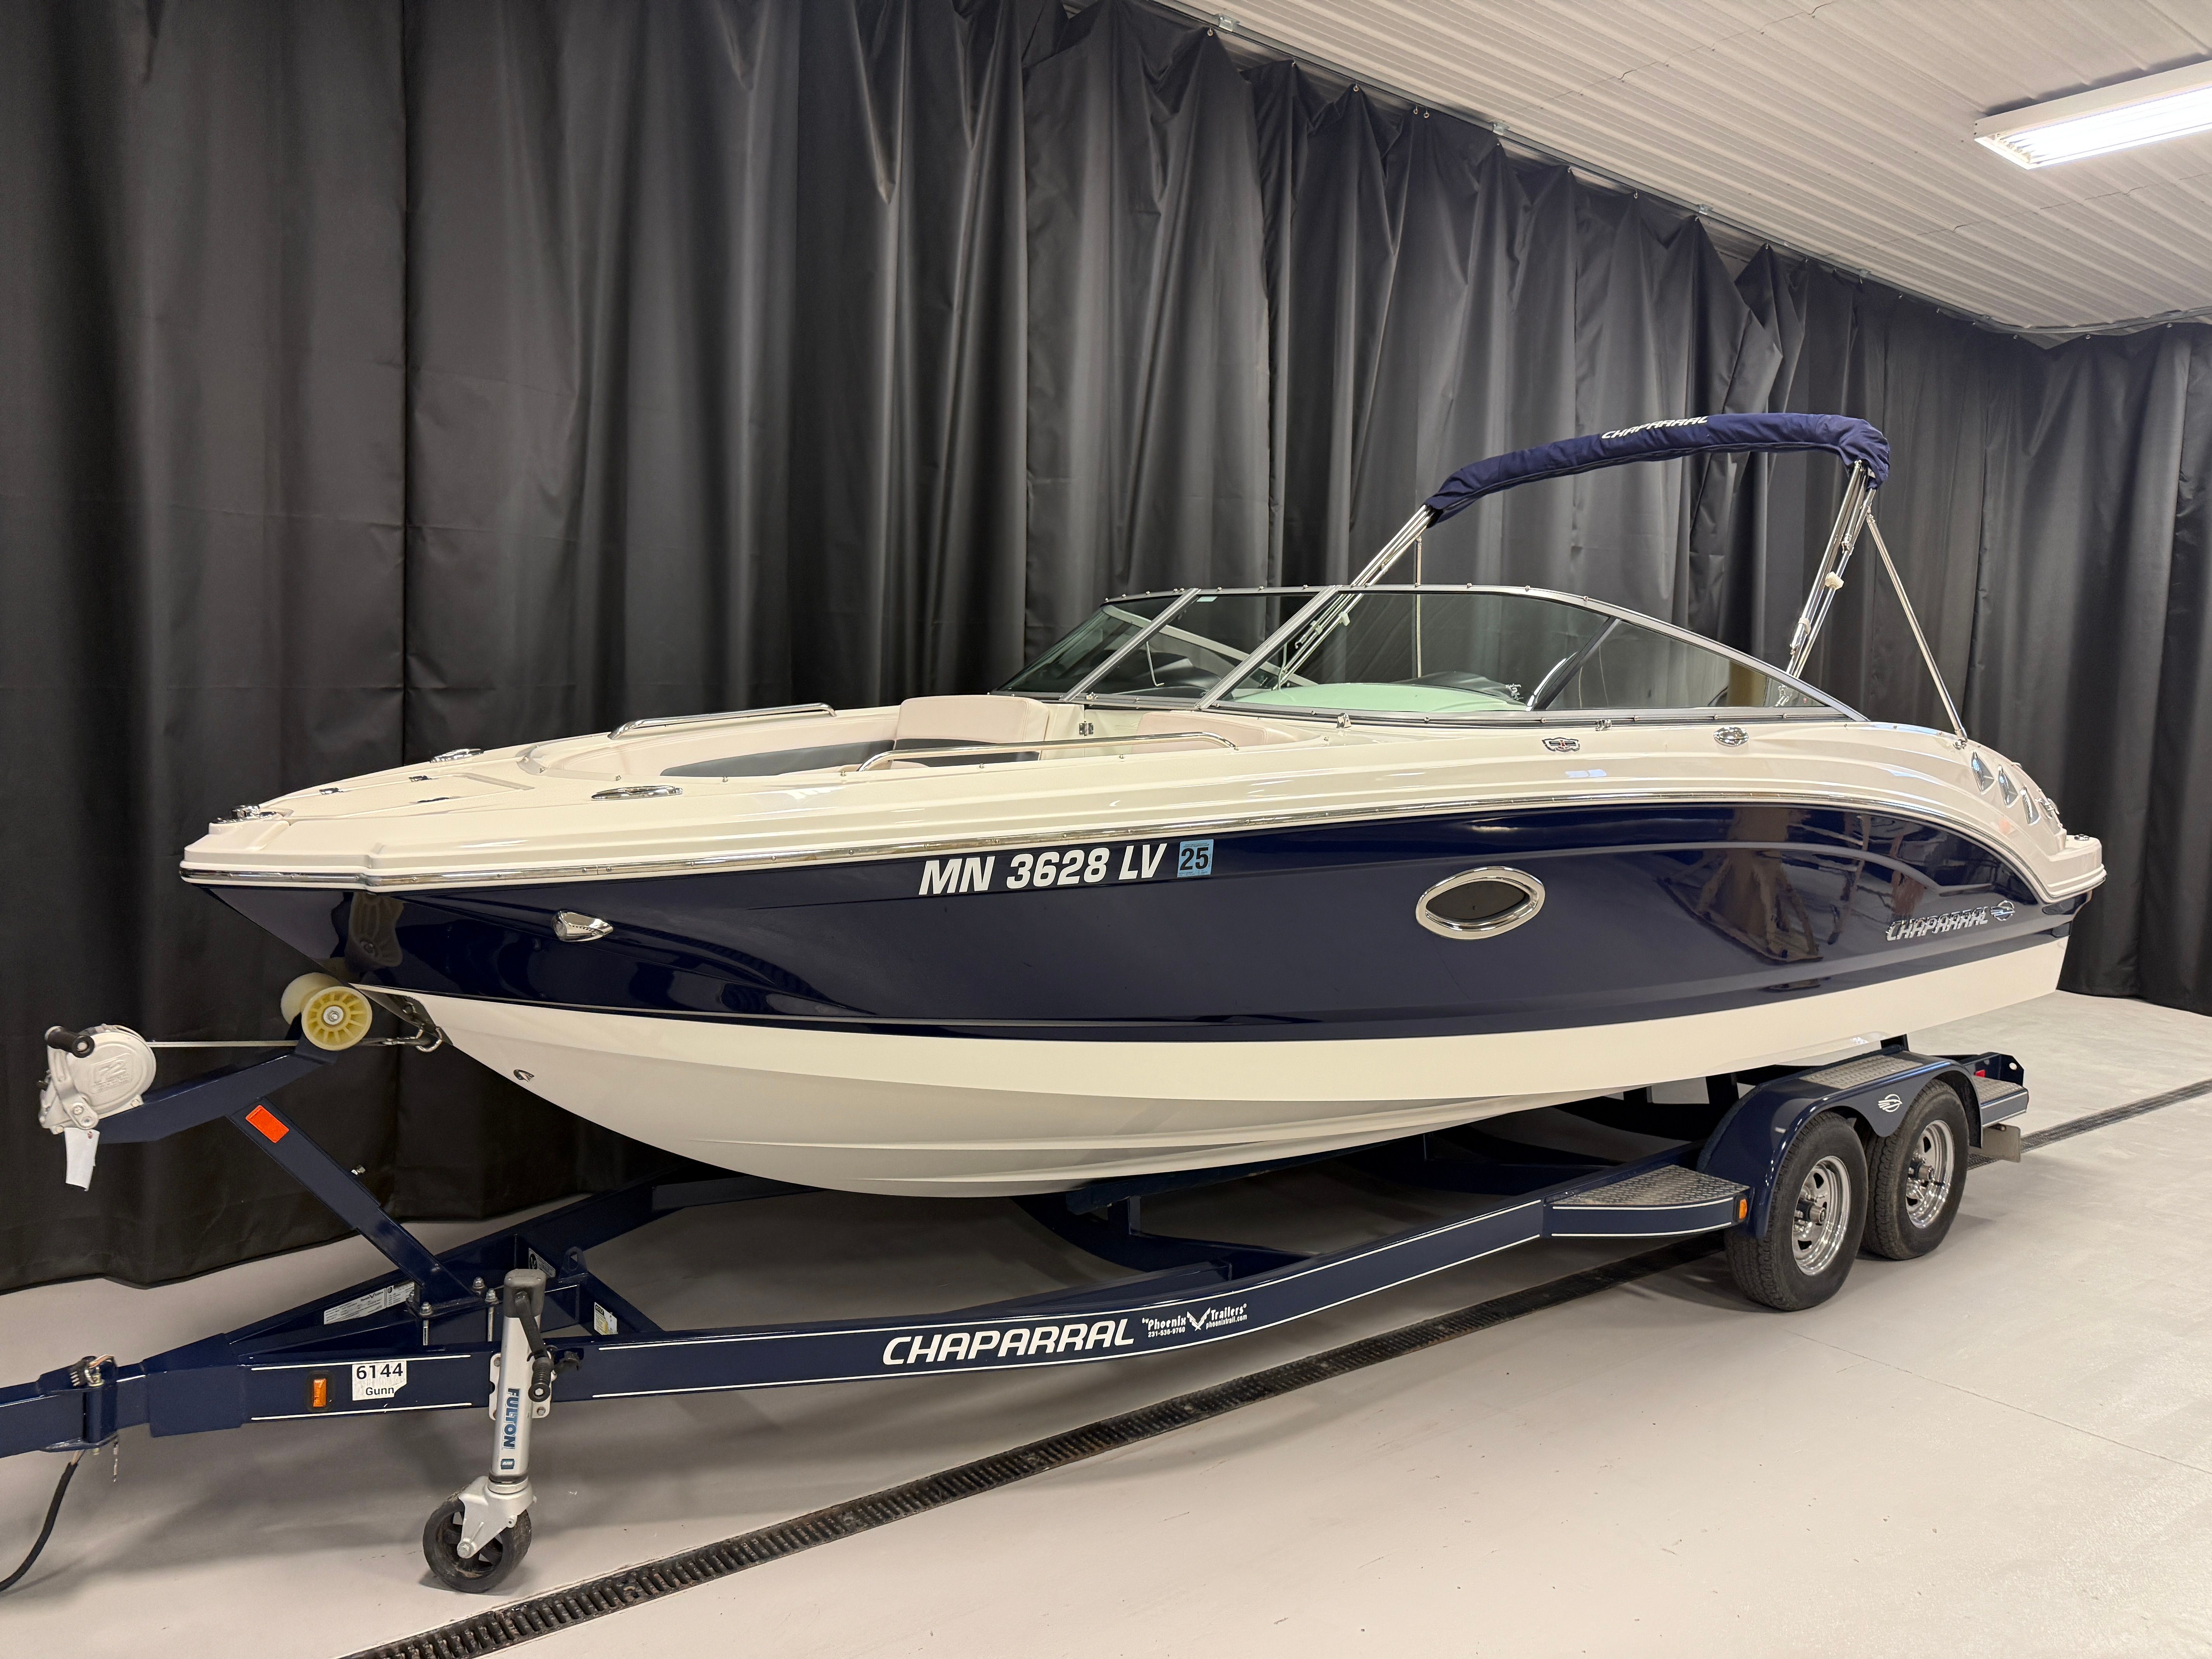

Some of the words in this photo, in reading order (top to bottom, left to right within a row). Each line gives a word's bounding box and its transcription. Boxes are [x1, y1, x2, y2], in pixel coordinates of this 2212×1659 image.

[919, 855, 995, 895] MN
[1006, 847, 1110, 889] 3628
[1118, 843, 1167, 880] LV
[1180, 847, 1209, 871] 25
[1886, 907, 1988, 941] CHAPARRAL
[1148, 1315, 1186, 1331] Phoenix
[1206, 1314, 1247, 1329] phoenixtrail.com
[883, 1319, 1134, 1365] CHAPARRAL
[356, 1363, 403, 1379] 6144
[366, 1387, 394, 1395] Gunn
[503, 1388, 519, 1449] FULTON
